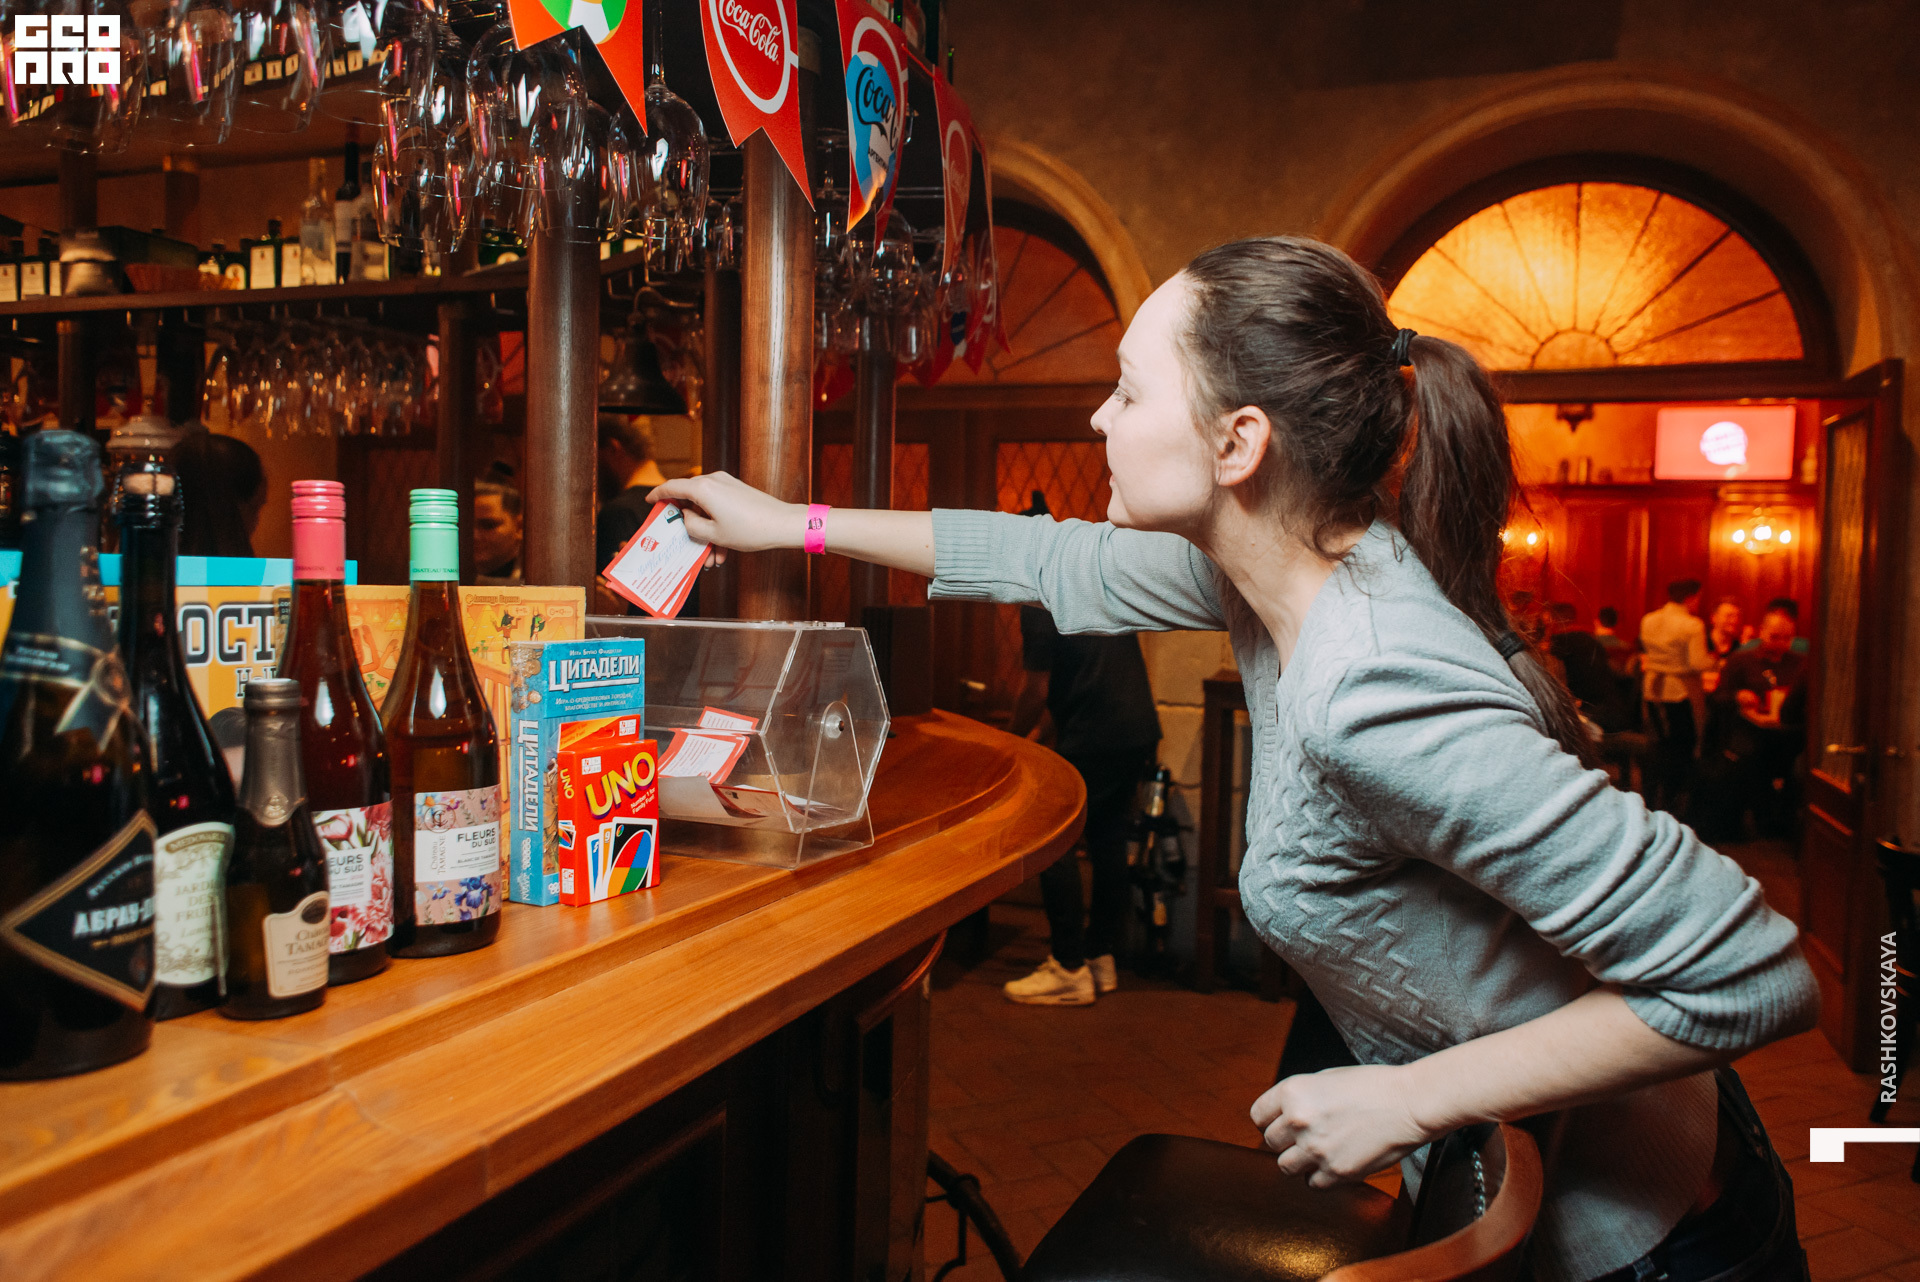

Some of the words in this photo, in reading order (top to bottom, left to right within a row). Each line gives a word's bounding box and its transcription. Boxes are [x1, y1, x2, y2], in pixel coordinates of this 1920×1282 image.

[548, 654, 641, 693] ЦИТАДЕЛИ
[517, 719, 539, 832] ЦИТАДЕЛИ
[560, 768, 575, 799] UNO
[585, 752, 656, 819] UNO
[630, 794, 646, 809] Number
[632, 801, 646, 815] Family
[457, 827, 496, 842] FLEURS
[472, 840, 483, 848] DU
[484, 837, 496, 846] SUD
[327, 853, 364, 868] EURS
[344, 864, 364, 874] SUD
[176, 879, 216, 896] JARDI
[73, 897, 155, 938] АБРАУ-Д
[176, 906, 213, 923] FRUI
